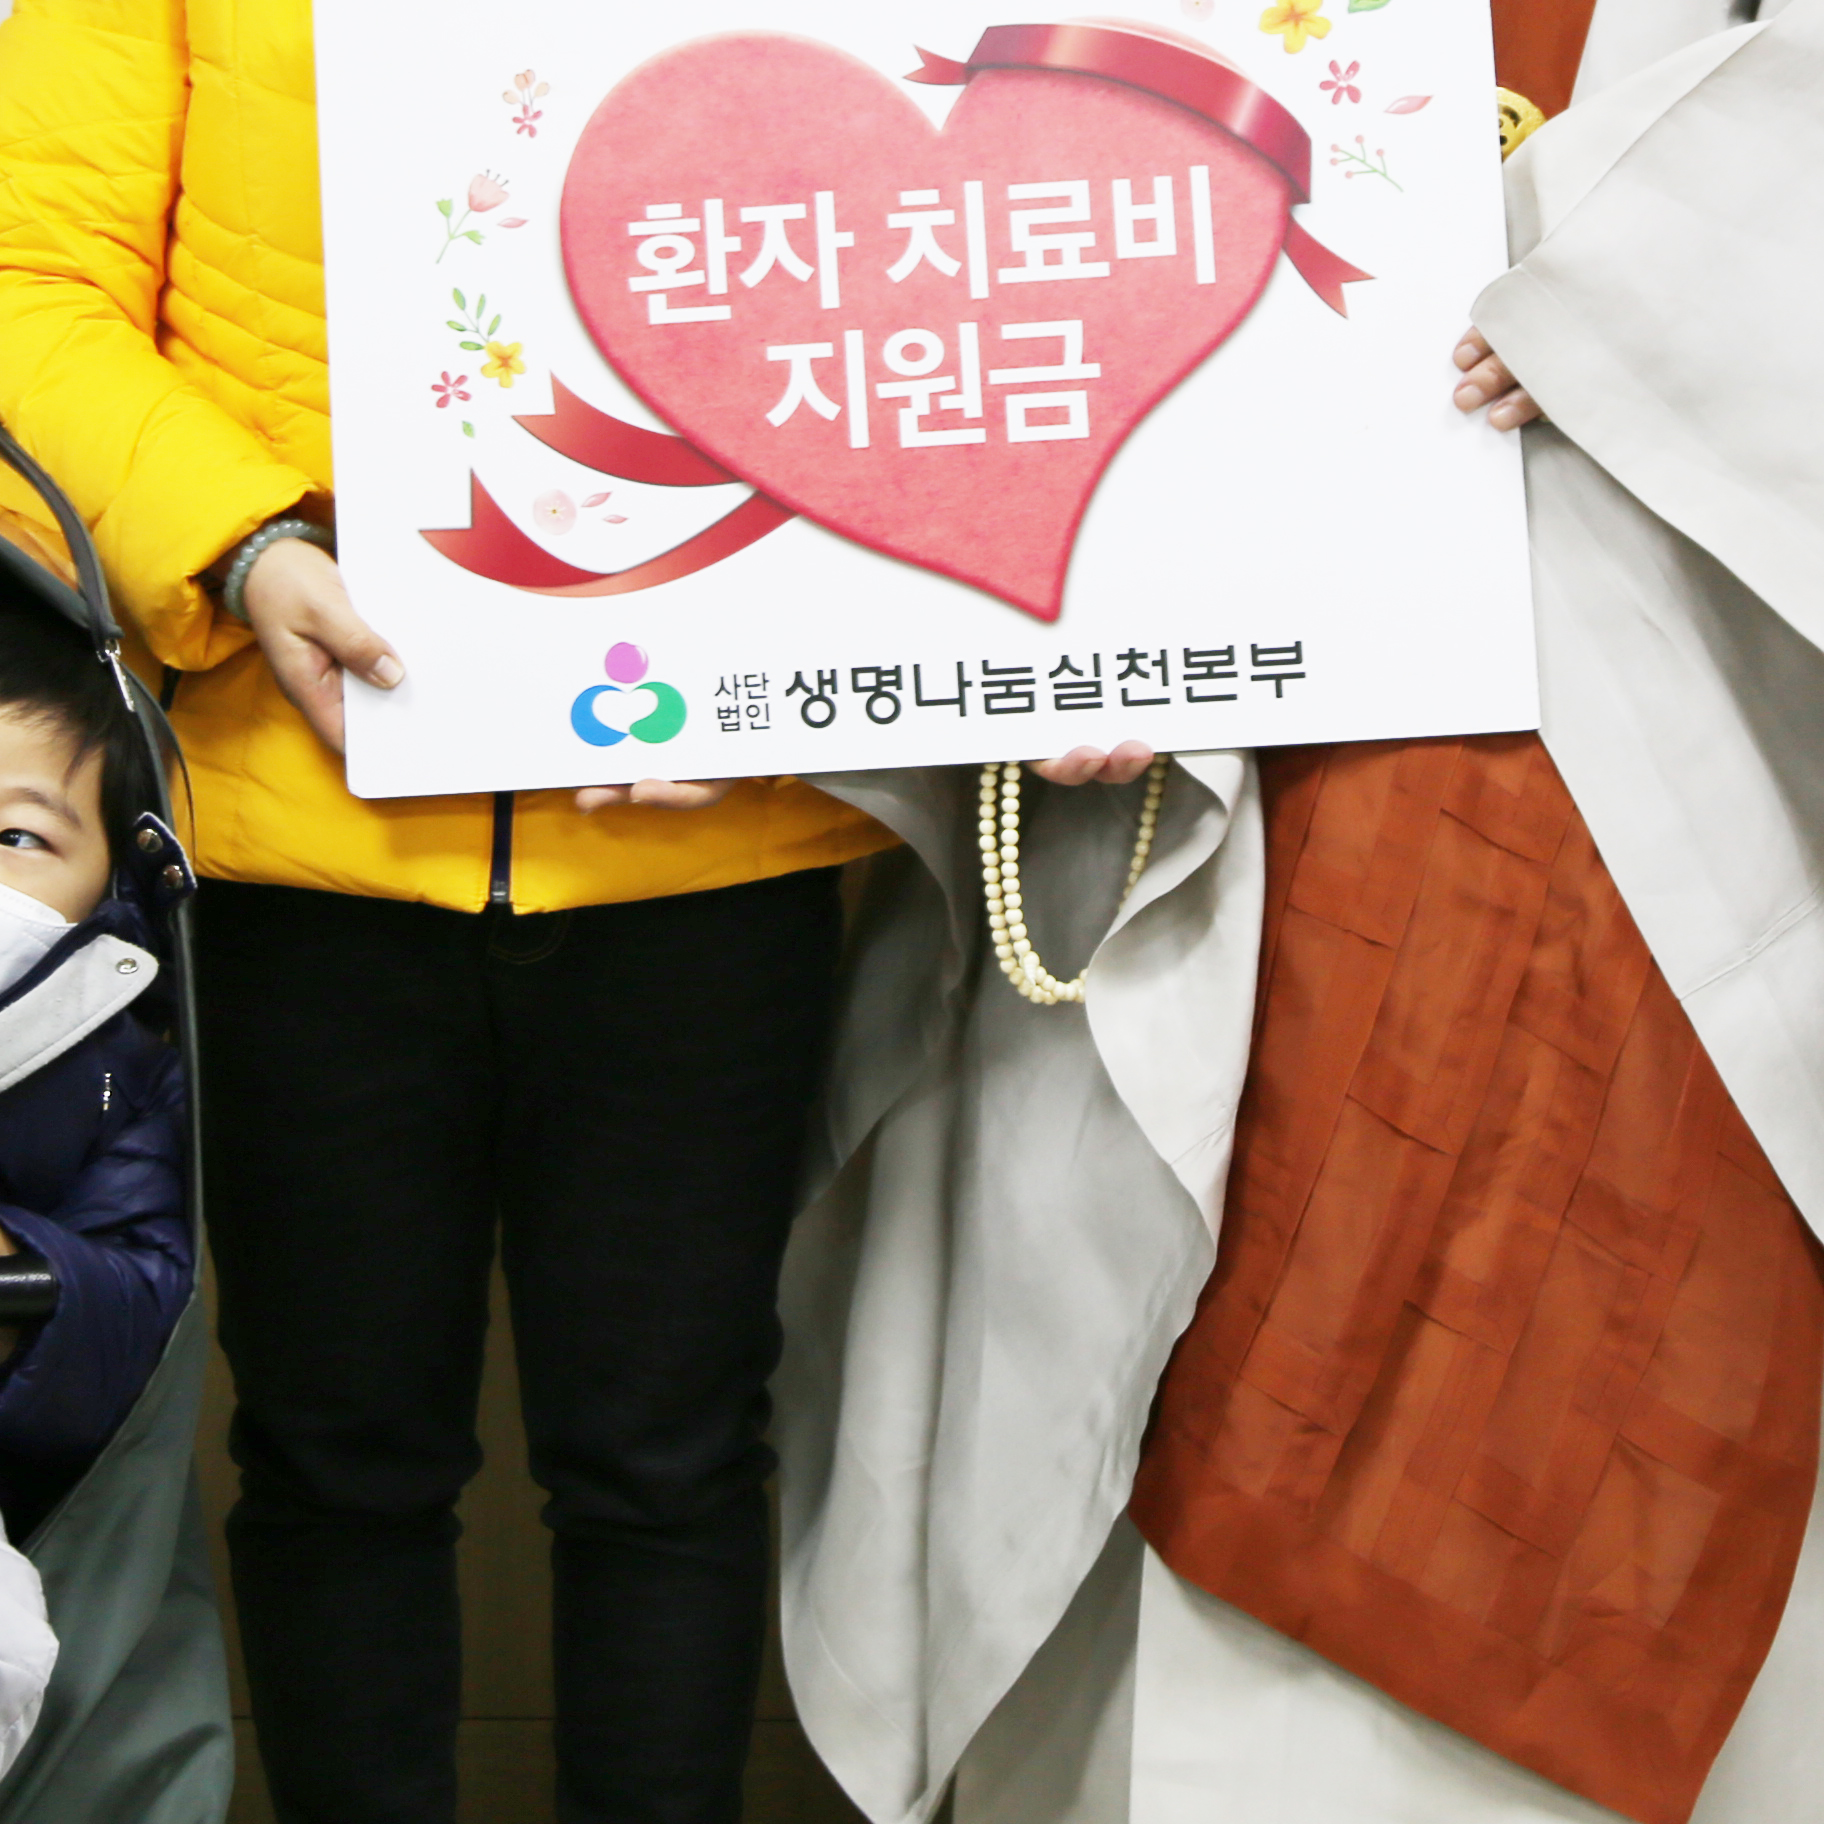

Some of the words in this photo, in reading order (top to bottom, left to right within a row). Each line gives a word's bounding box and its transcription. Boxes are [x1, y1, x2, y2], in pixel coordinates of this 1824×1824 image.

[627, 189, 855, 326] 환자
[885, 164, 1218, 299] 치료비
[764, 319, 1101, 450] 지원금
[713, 672, 770, 701] 사단
[715, 704, 772, 733] 법인
[784, 639, 1307, 730] 생명나눔실천본부
